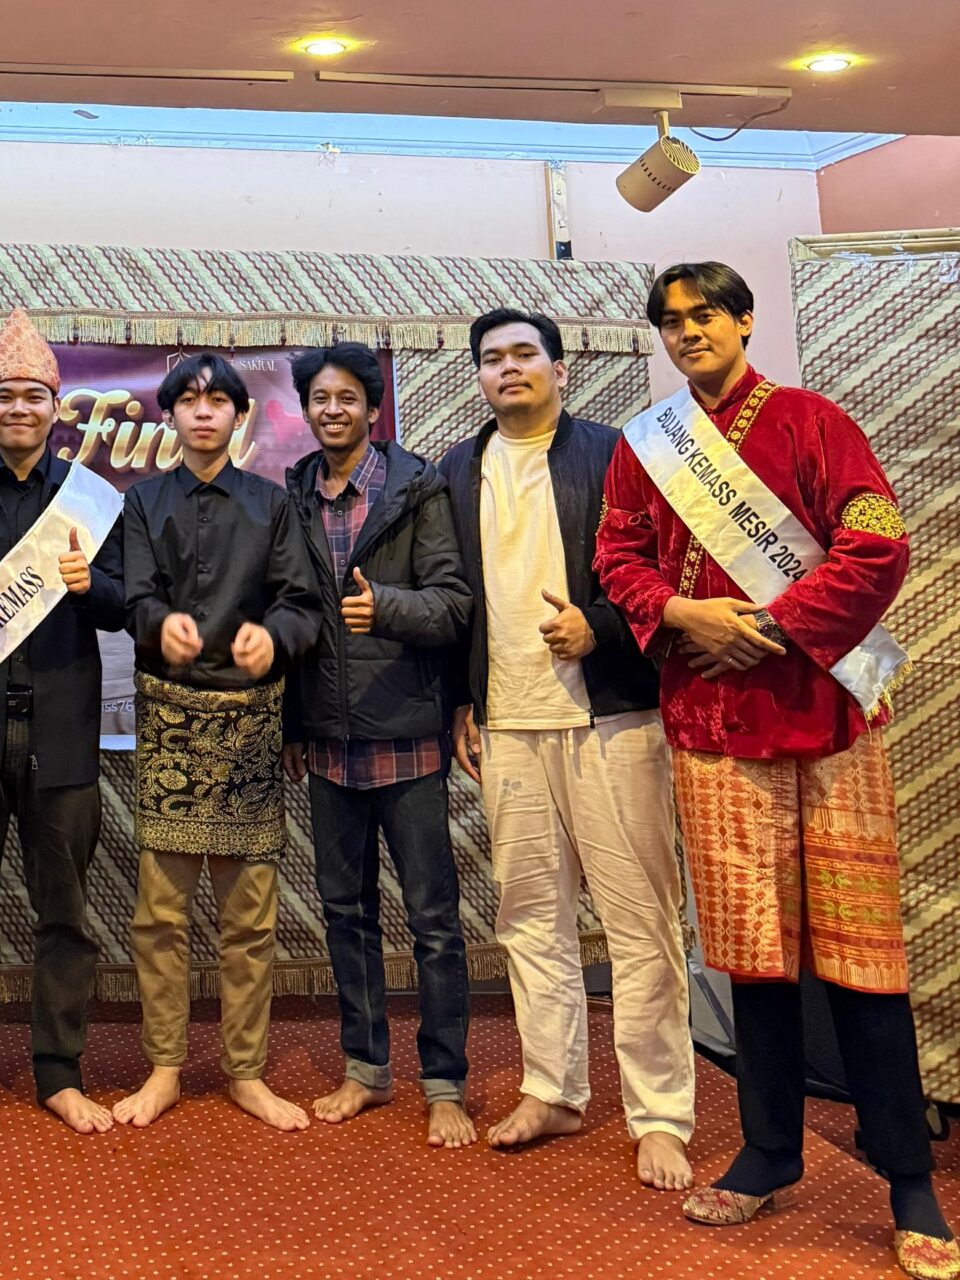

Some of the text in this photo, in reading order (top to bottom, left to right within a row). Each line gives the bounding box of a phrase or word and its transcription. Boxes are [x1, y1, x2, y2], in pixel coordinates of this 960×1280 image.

[240, 360, 278, 371] SAKRAL
[57, 388, 256, 470] Finl
[656, 406, 808, 584] BUJANG KEMASS MESIR 2024
